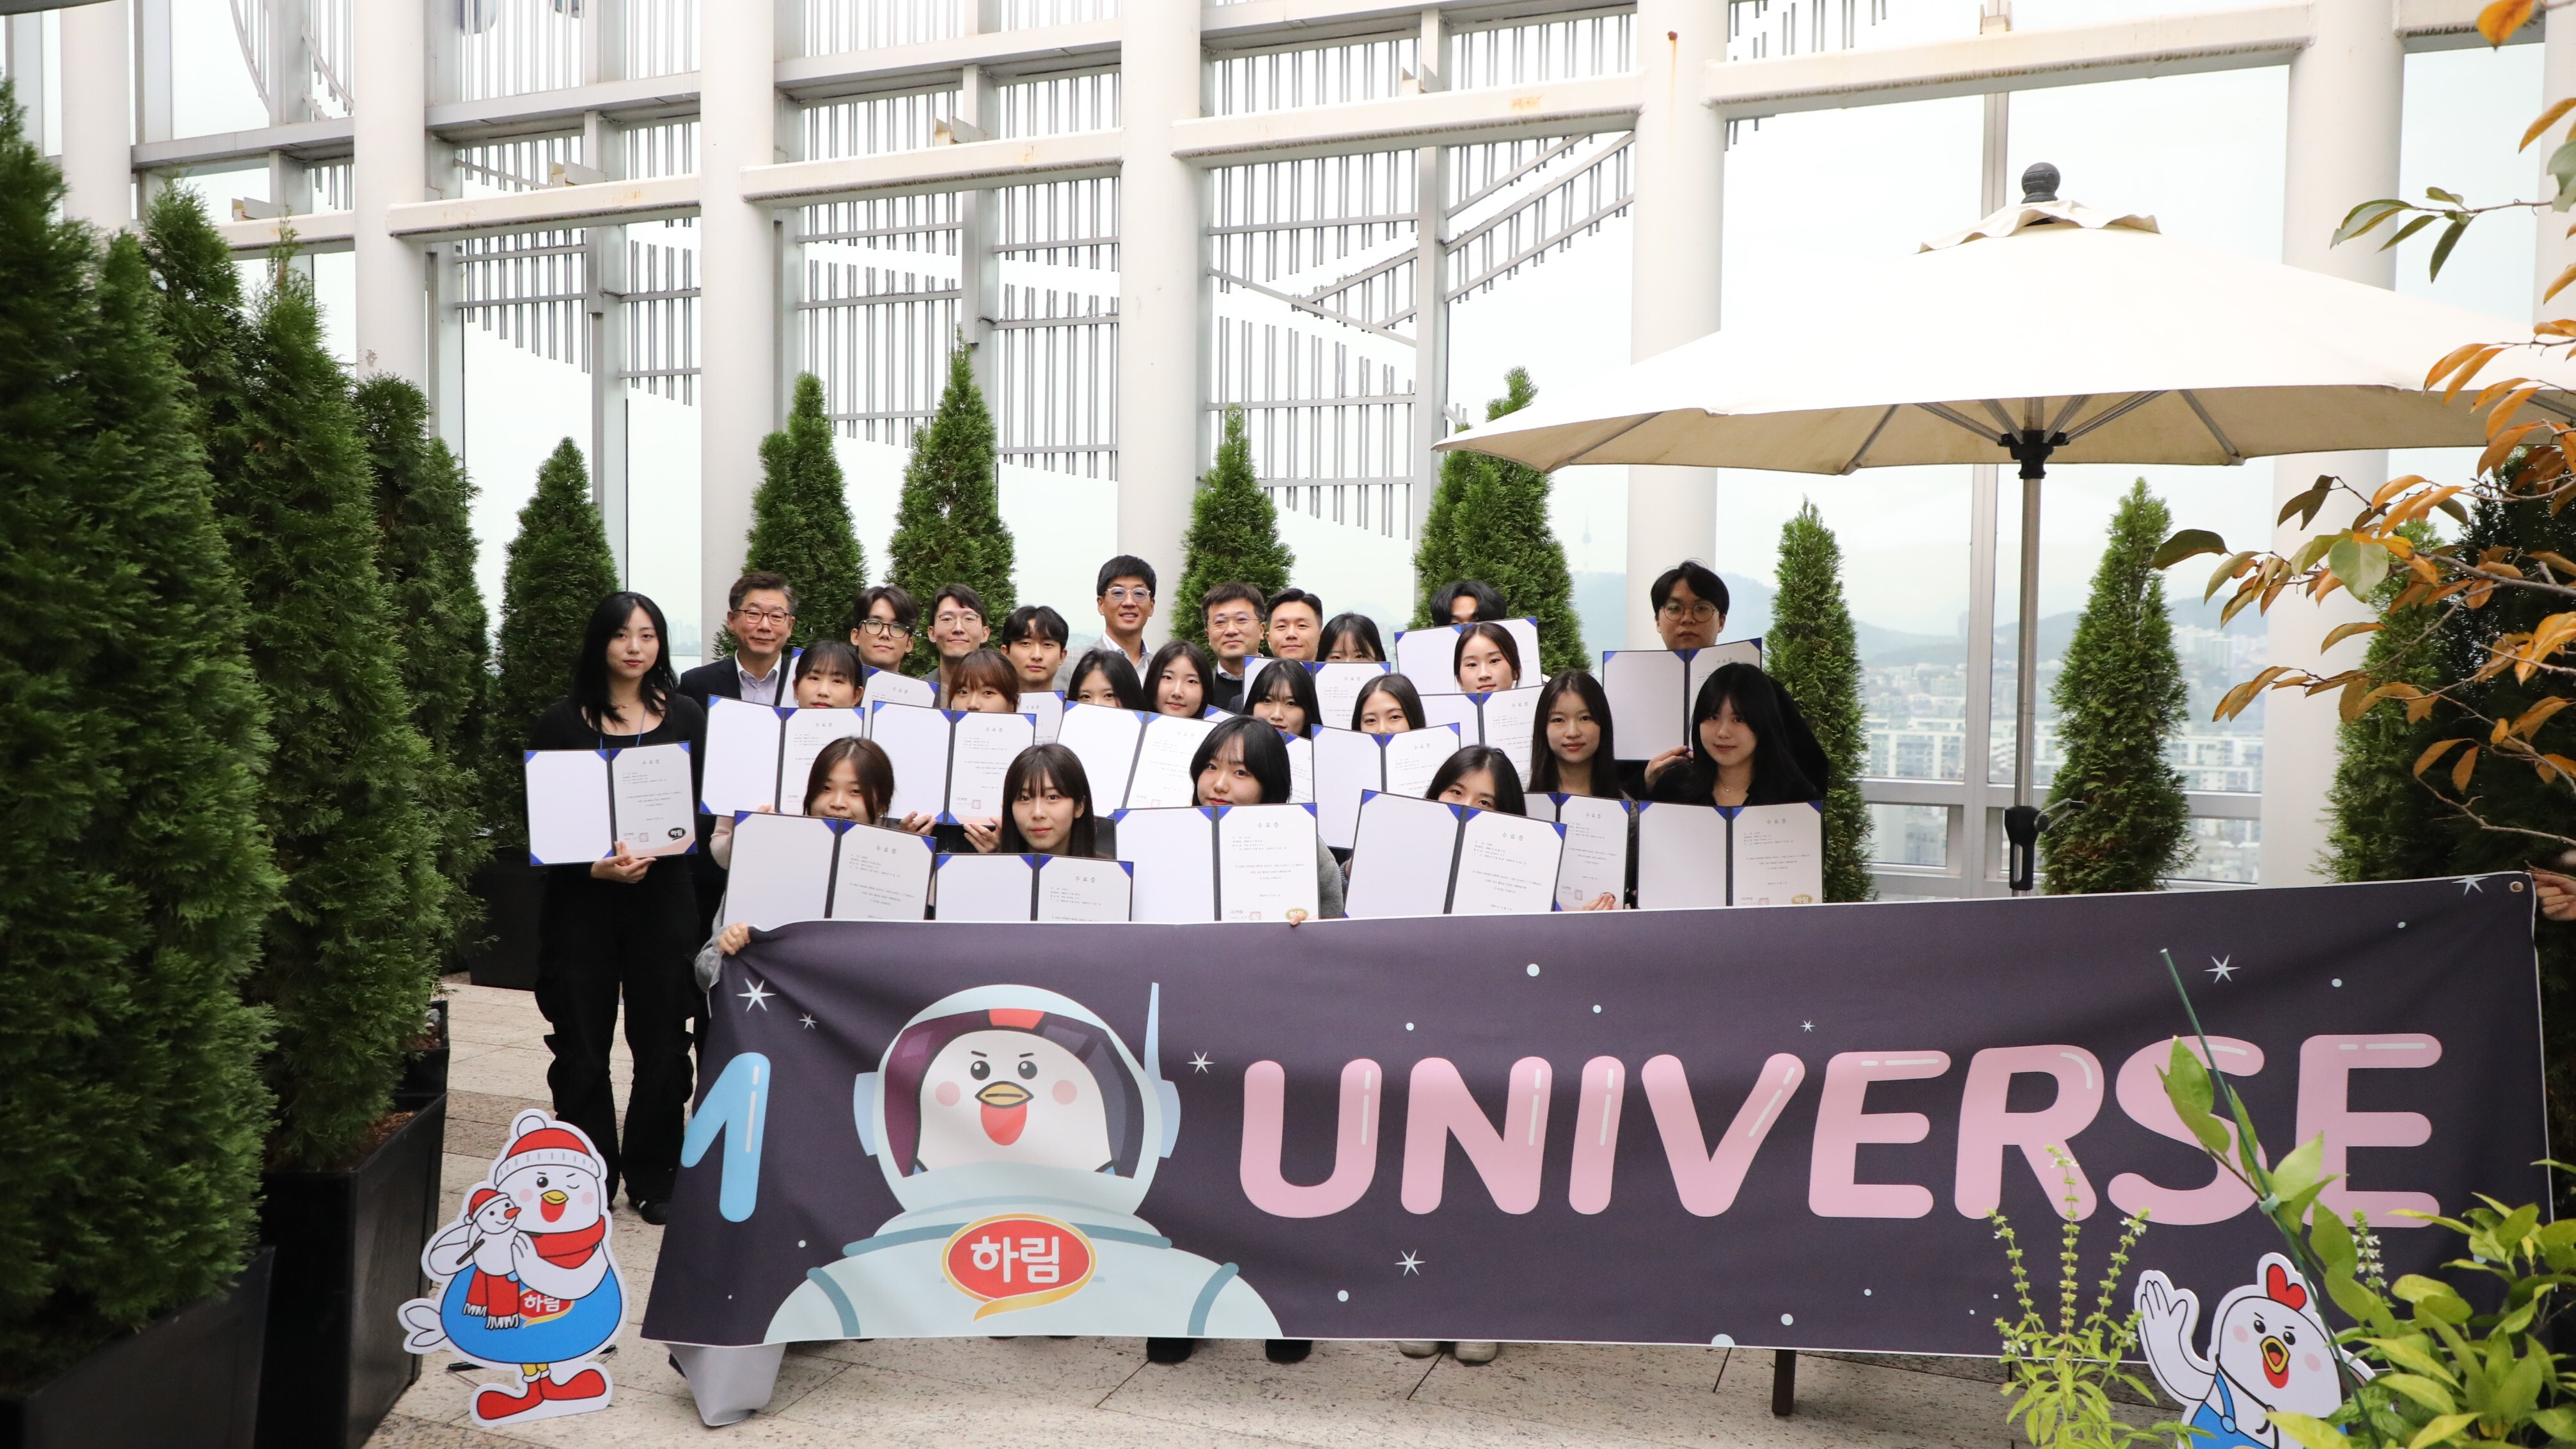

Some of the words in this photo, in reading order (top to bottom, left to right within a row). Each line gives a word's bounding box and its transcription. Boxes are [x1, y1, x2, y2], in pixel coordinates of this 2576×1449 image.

[1502, 833, 1524, 841] 수료증
[876, 845, 897, 854] 수료증
[1239, 1033, 2442, 1228] UNIVERSE
[970, 1235, 1060, 1283] 하림
[524, 1294, 560, 1313] 하림
